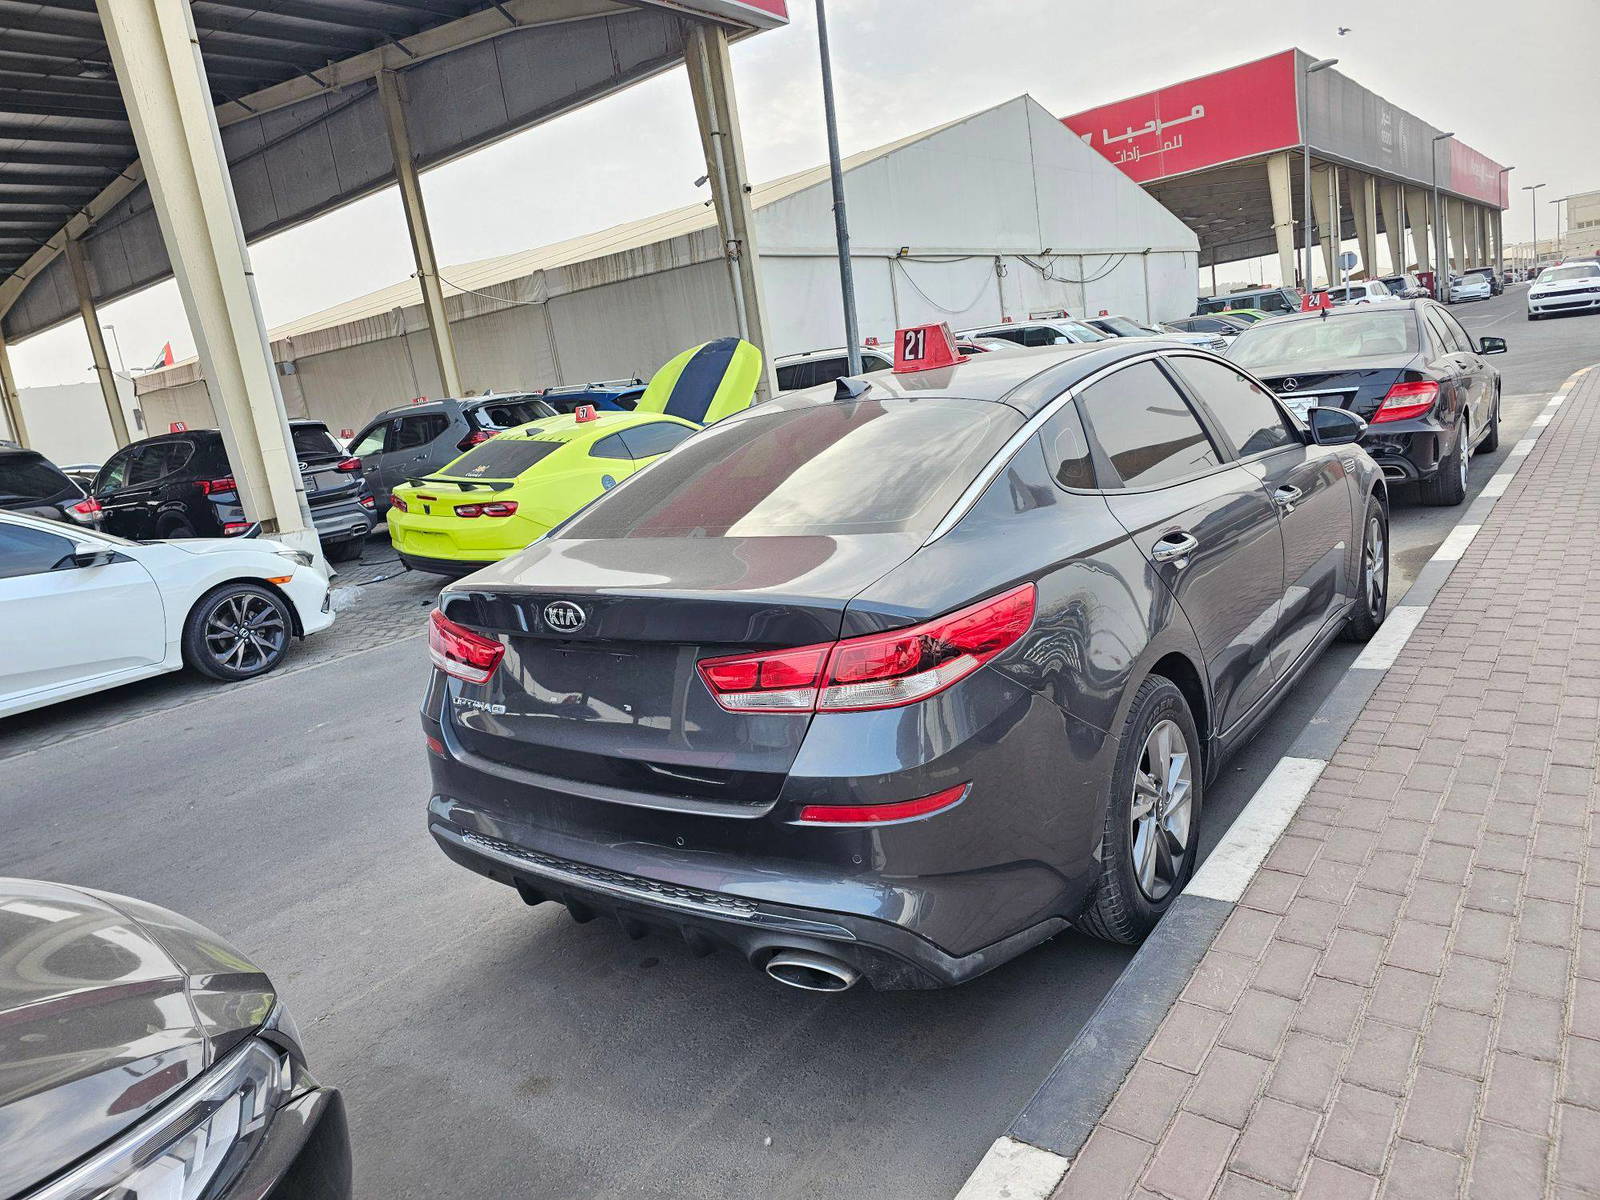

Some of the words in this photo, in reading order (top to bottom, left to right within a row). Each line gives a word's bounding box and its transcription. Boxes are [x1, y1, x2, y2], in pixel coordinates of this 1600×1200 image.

[1308, 295, 1320, 307] 24
[905, 329, 924, 360] 21
[548, 607, 578, 626] KIA
